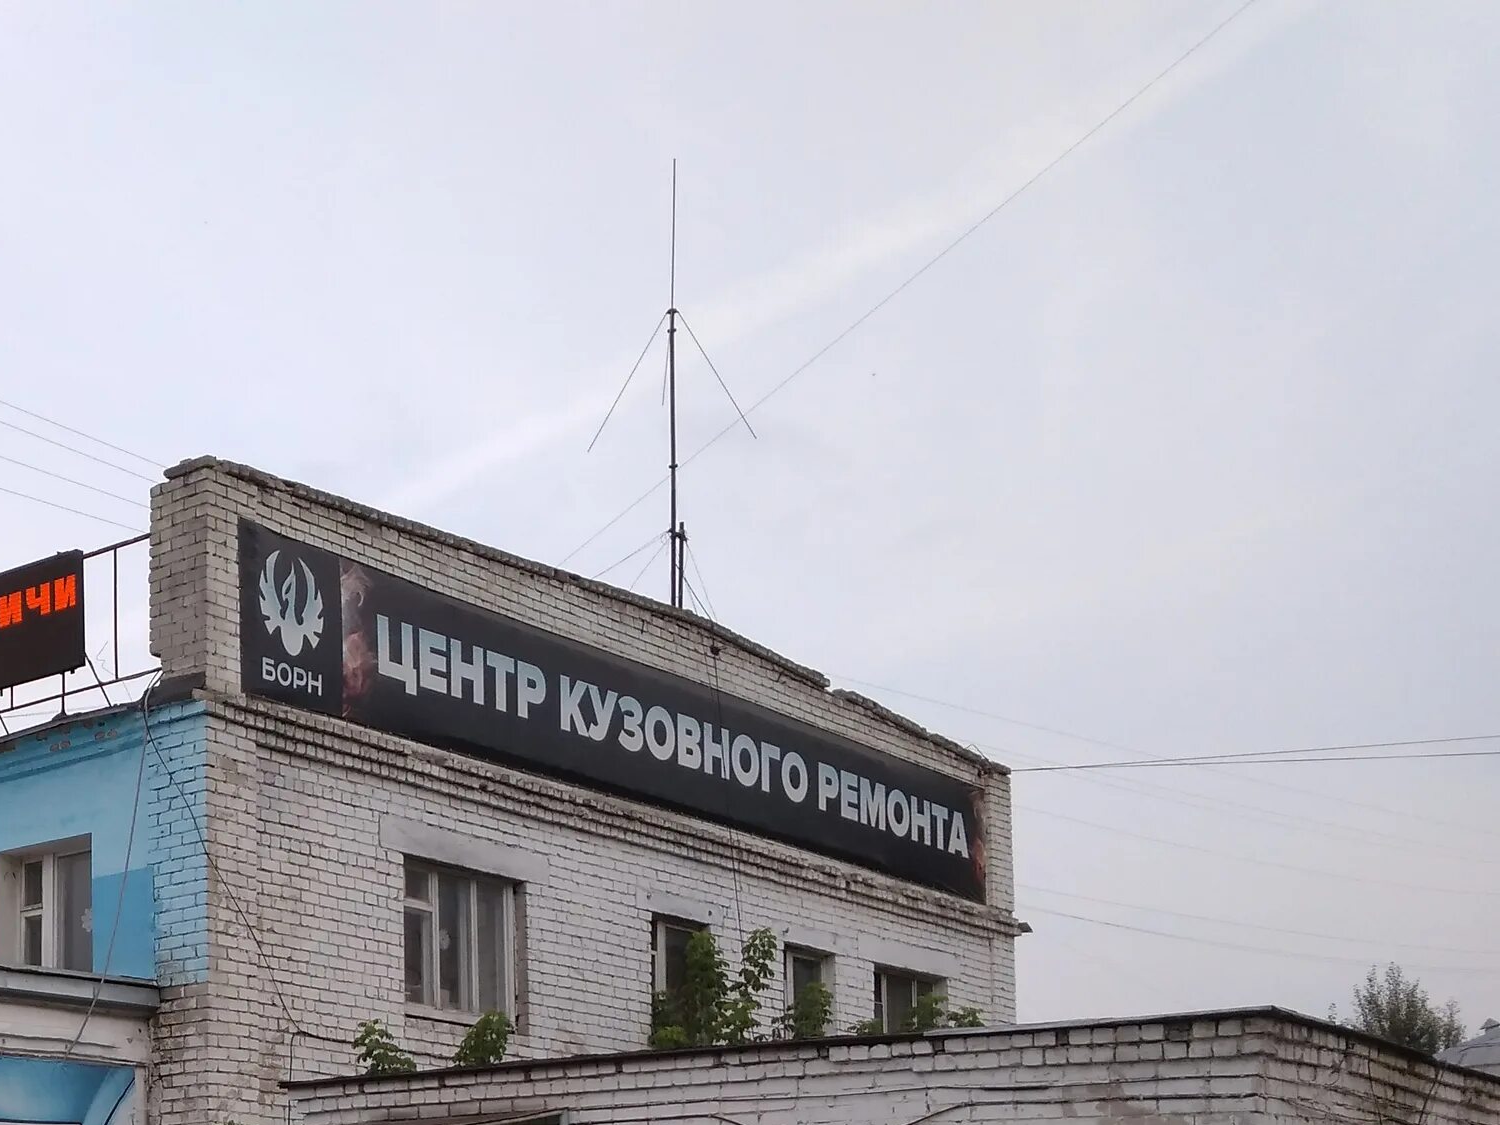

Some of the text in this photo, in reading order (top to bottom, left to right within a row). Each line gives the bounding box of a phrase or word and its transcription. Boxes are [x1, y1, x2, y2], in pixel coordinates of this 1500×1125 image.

[262, 656, 323, 697] БОРН
[376, 613, 971, 859] ЦЕНТР КУЗОВНОГО РЕМОНТА
